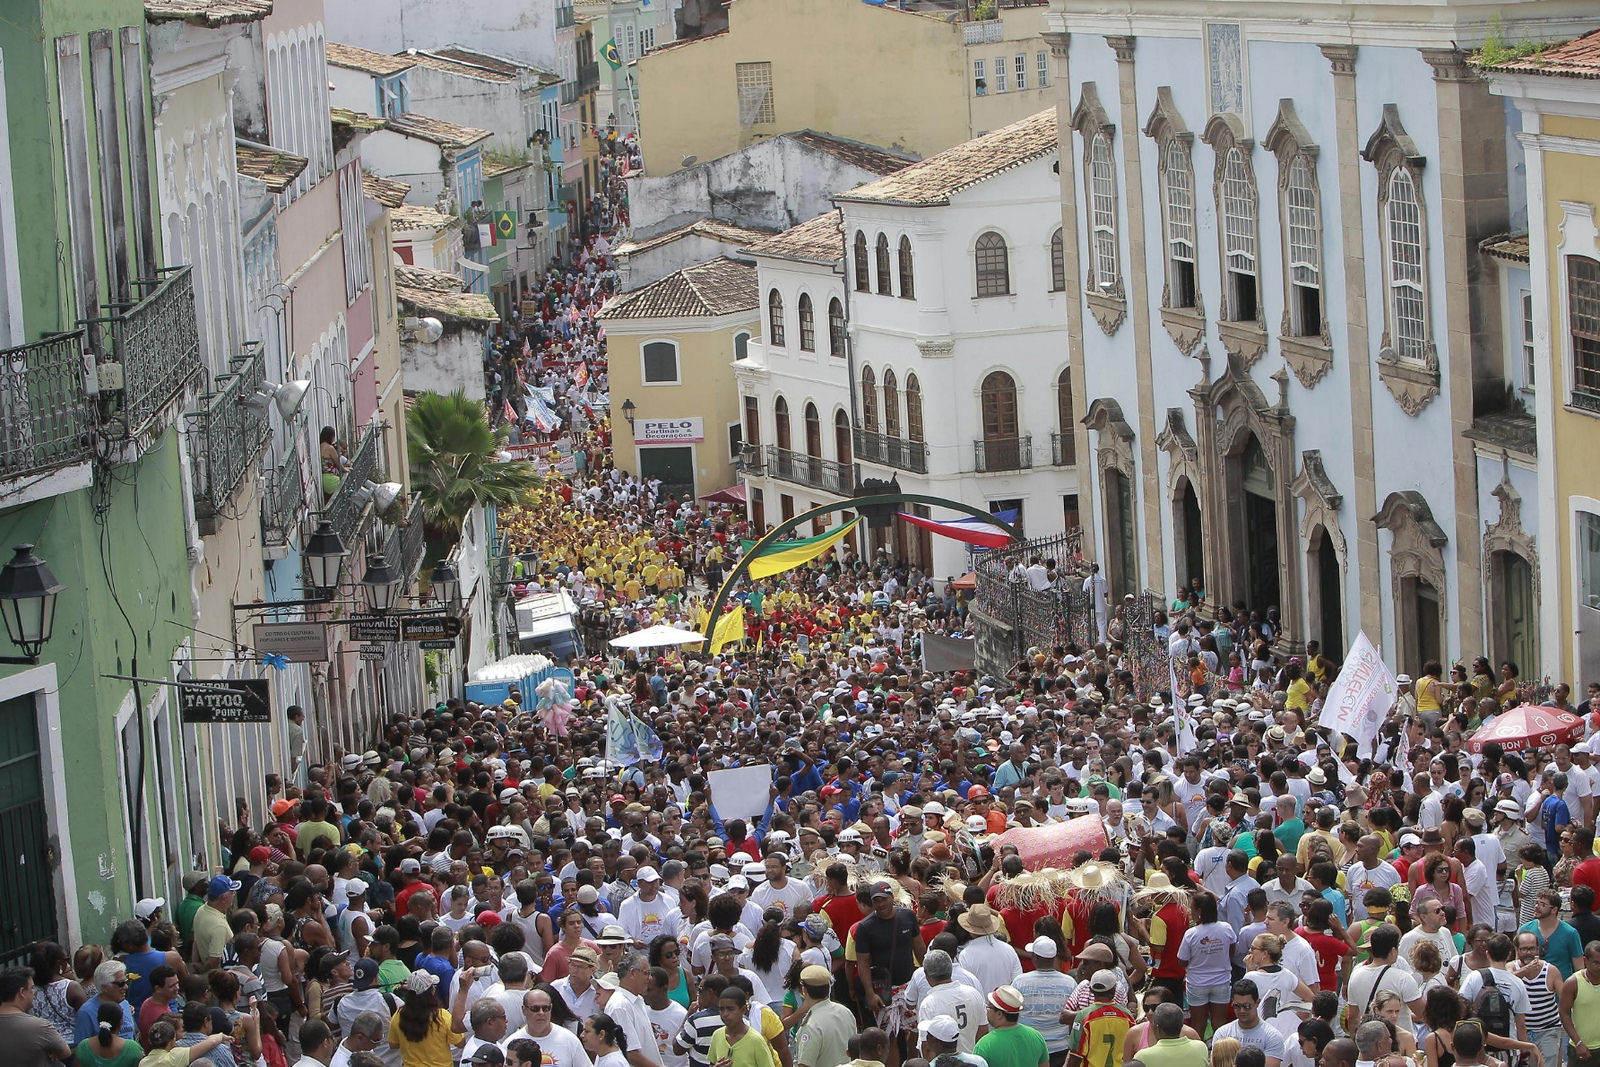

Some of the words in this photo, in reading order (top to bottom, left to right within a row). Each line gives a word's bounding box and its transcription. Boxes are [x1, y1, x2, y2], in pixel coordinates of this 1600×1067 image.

[645, 421, 692, 429] PELO
[185, 694, 243, 707] TATTOO
[215, 708, 242, 717] POINT
[954, 1004, 968, 1030] 5
[1102, 1033, 1116, 1067] 7
